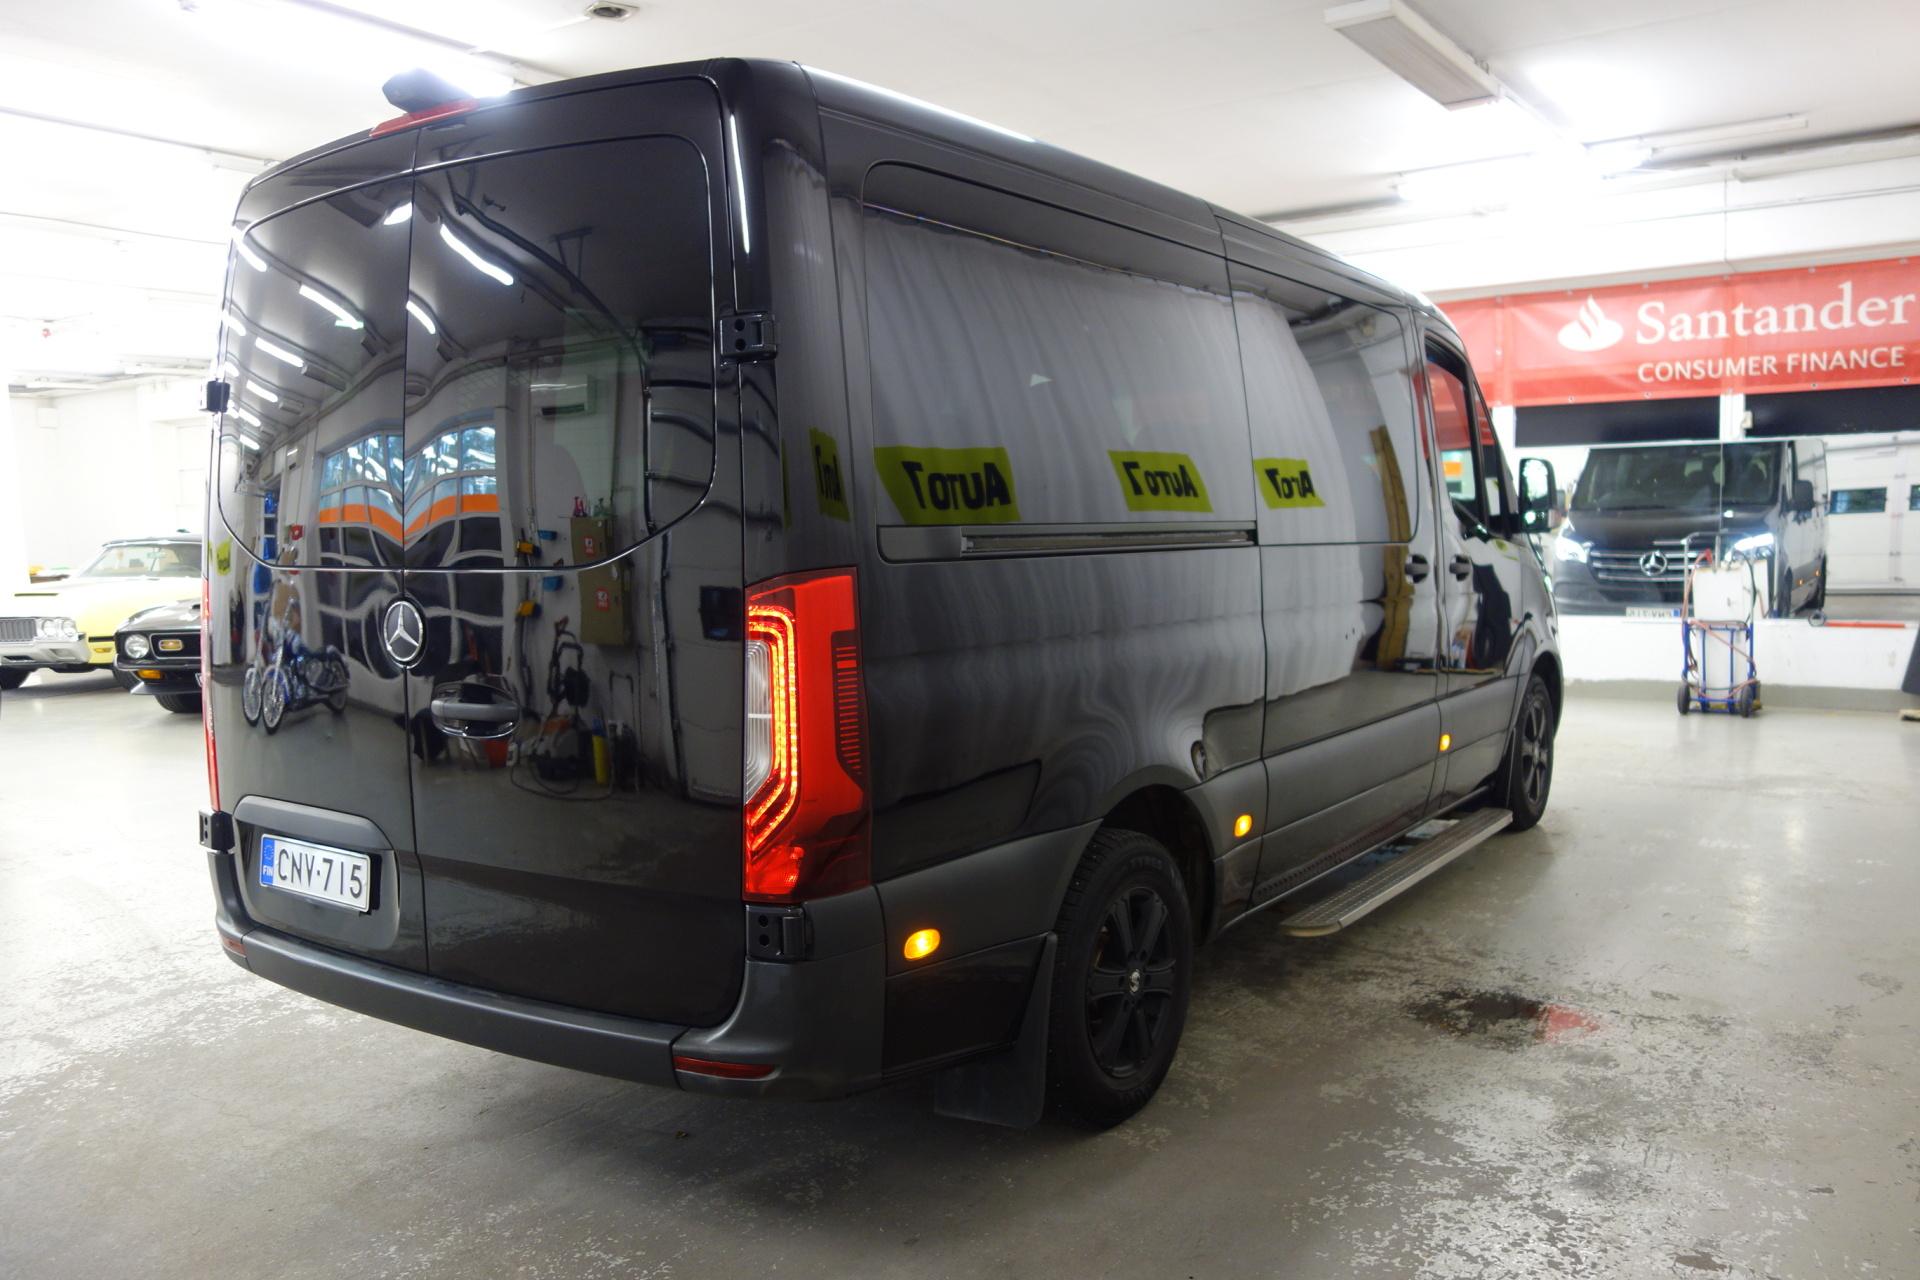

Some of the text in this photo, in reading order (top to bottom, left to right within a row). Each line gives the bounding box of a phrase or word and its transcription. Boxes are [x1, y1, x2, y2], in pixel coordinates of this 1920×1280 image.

[1635, 281, 1915, 345] Santander
[1637, 346, 1905, 383] CONSUMER FINANCE
[262, 848, 363, 899] FIN CNV-715
